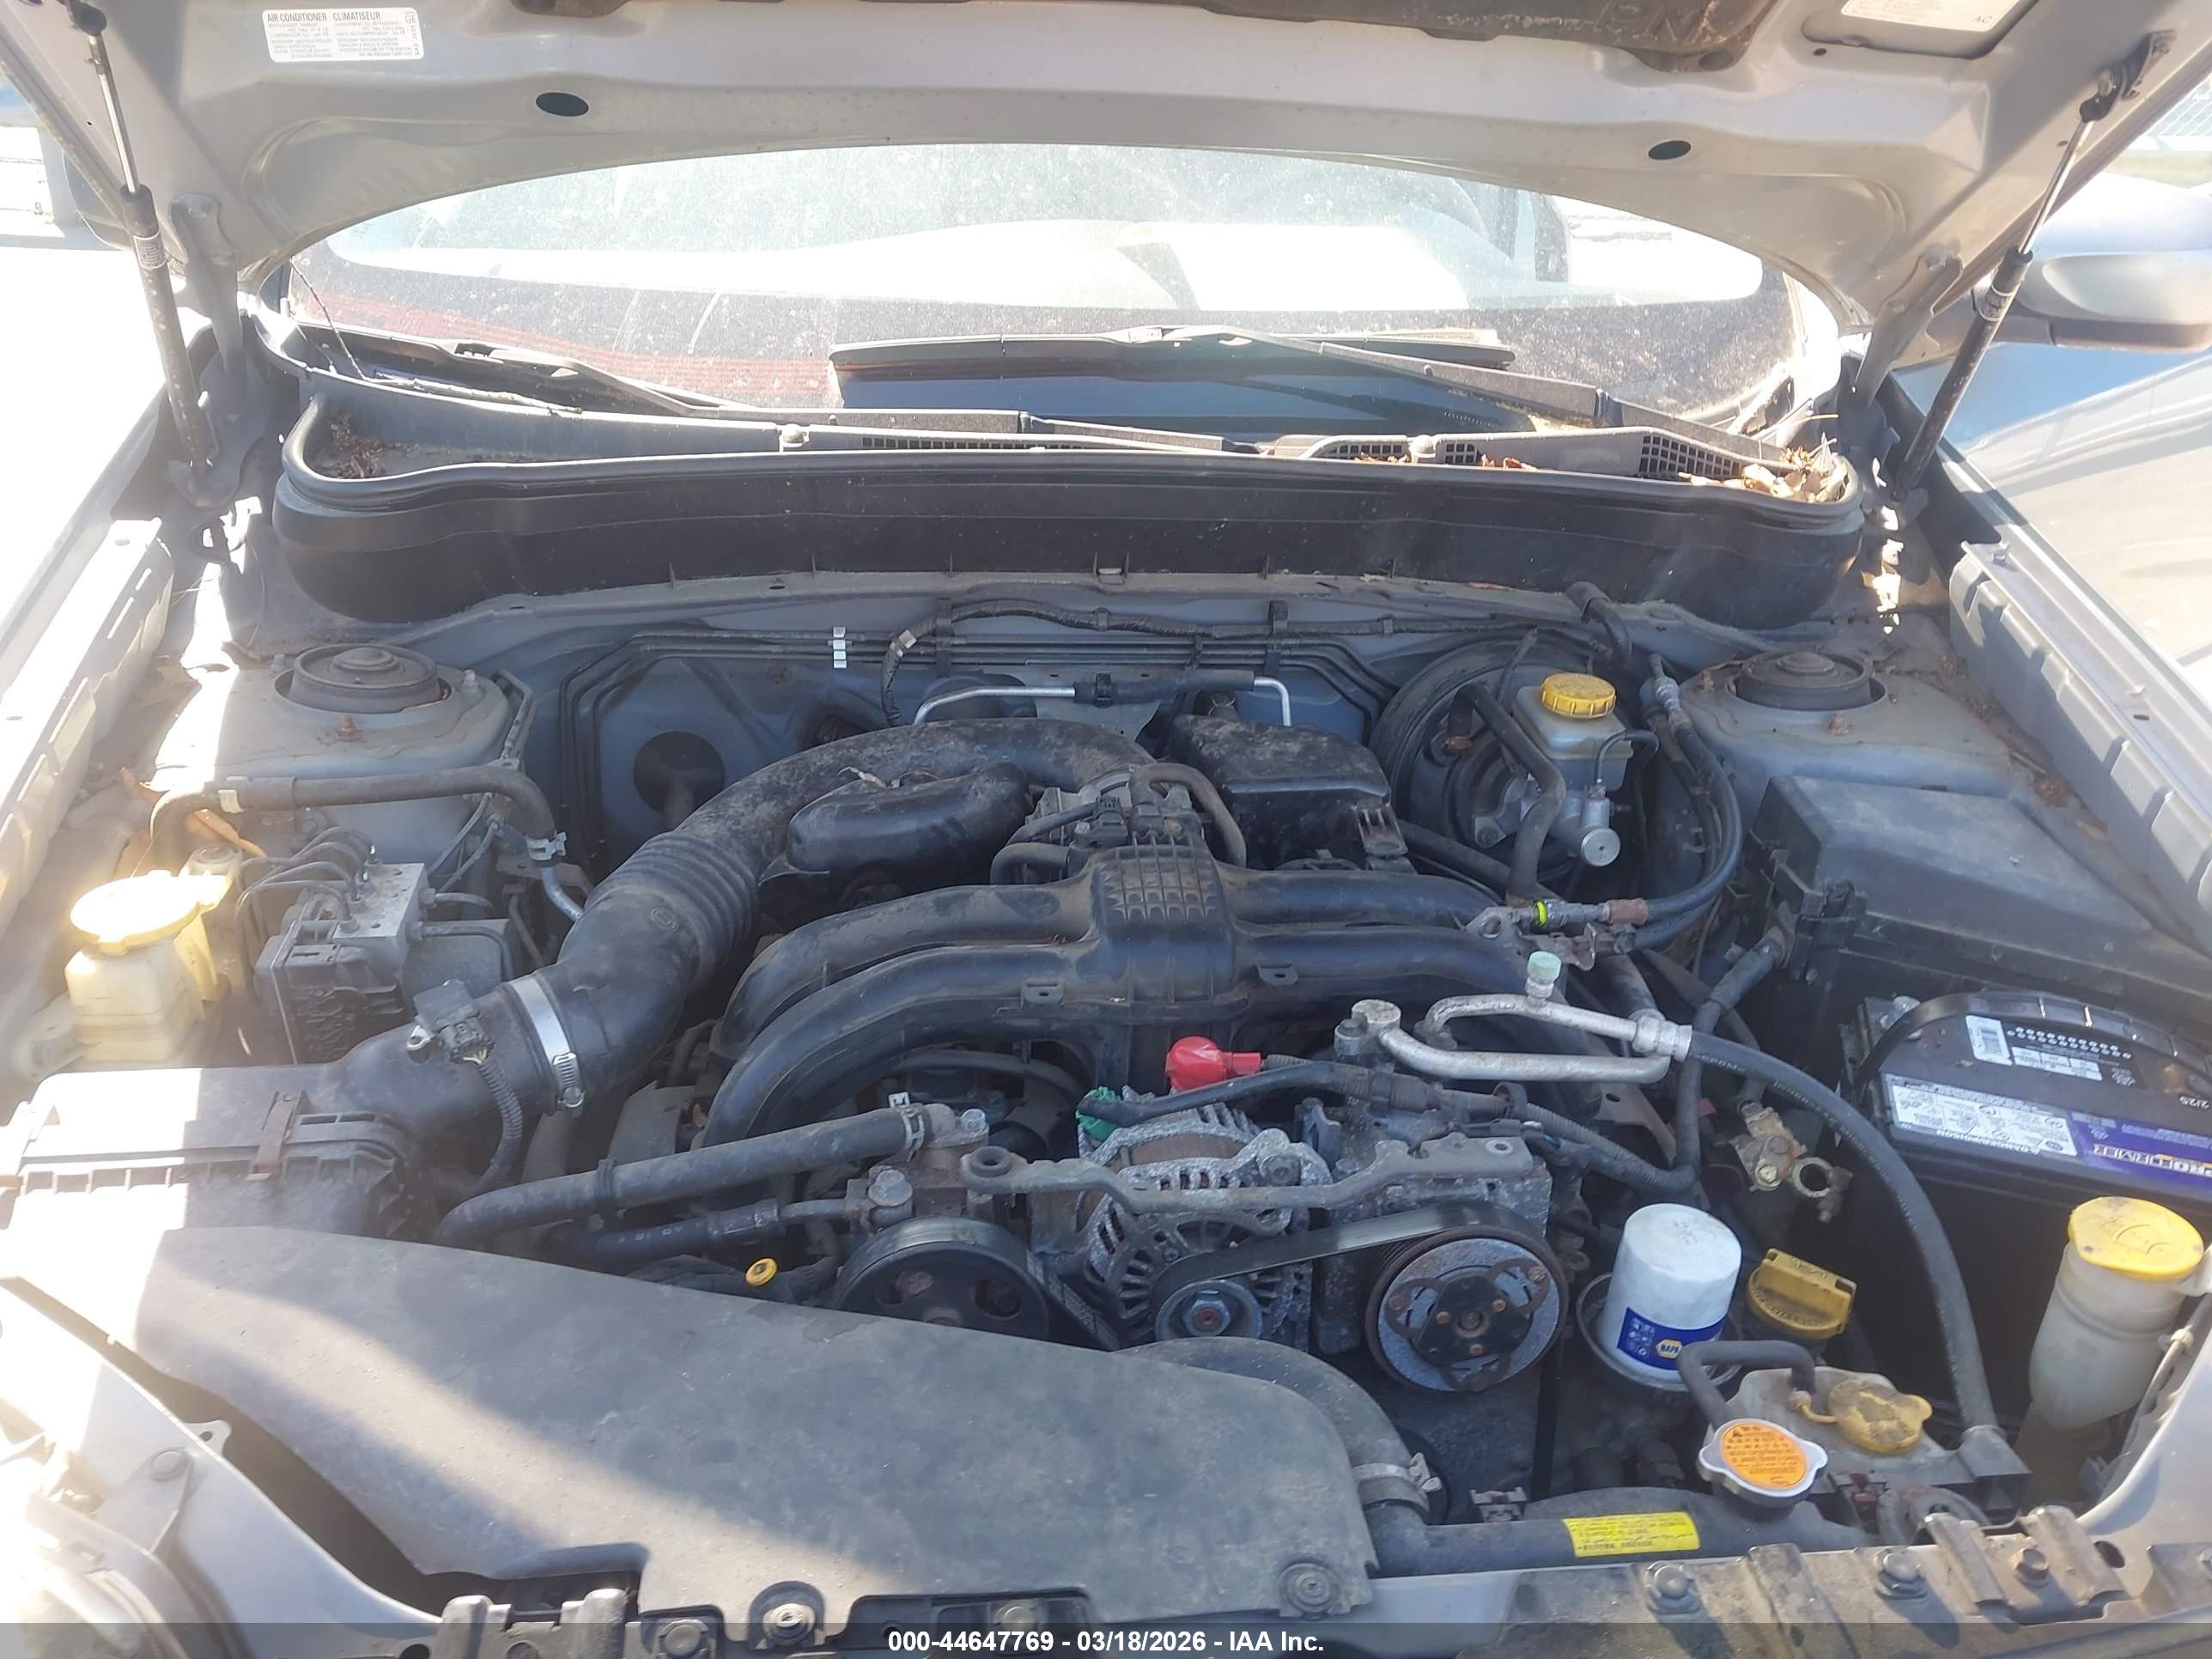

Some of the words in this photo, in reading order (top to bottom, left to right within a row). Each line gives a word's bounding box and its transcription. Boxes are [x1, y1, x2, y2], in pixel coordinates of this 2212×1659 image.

[267, 13, 279, 22] AIR
[279, 12, 327, 22] CONDITIONER
[332, 11, 381, 21] CLIMATISEUR
[404, 15, 417, 24] GE
[1972, 15, 1993, 24] AC
